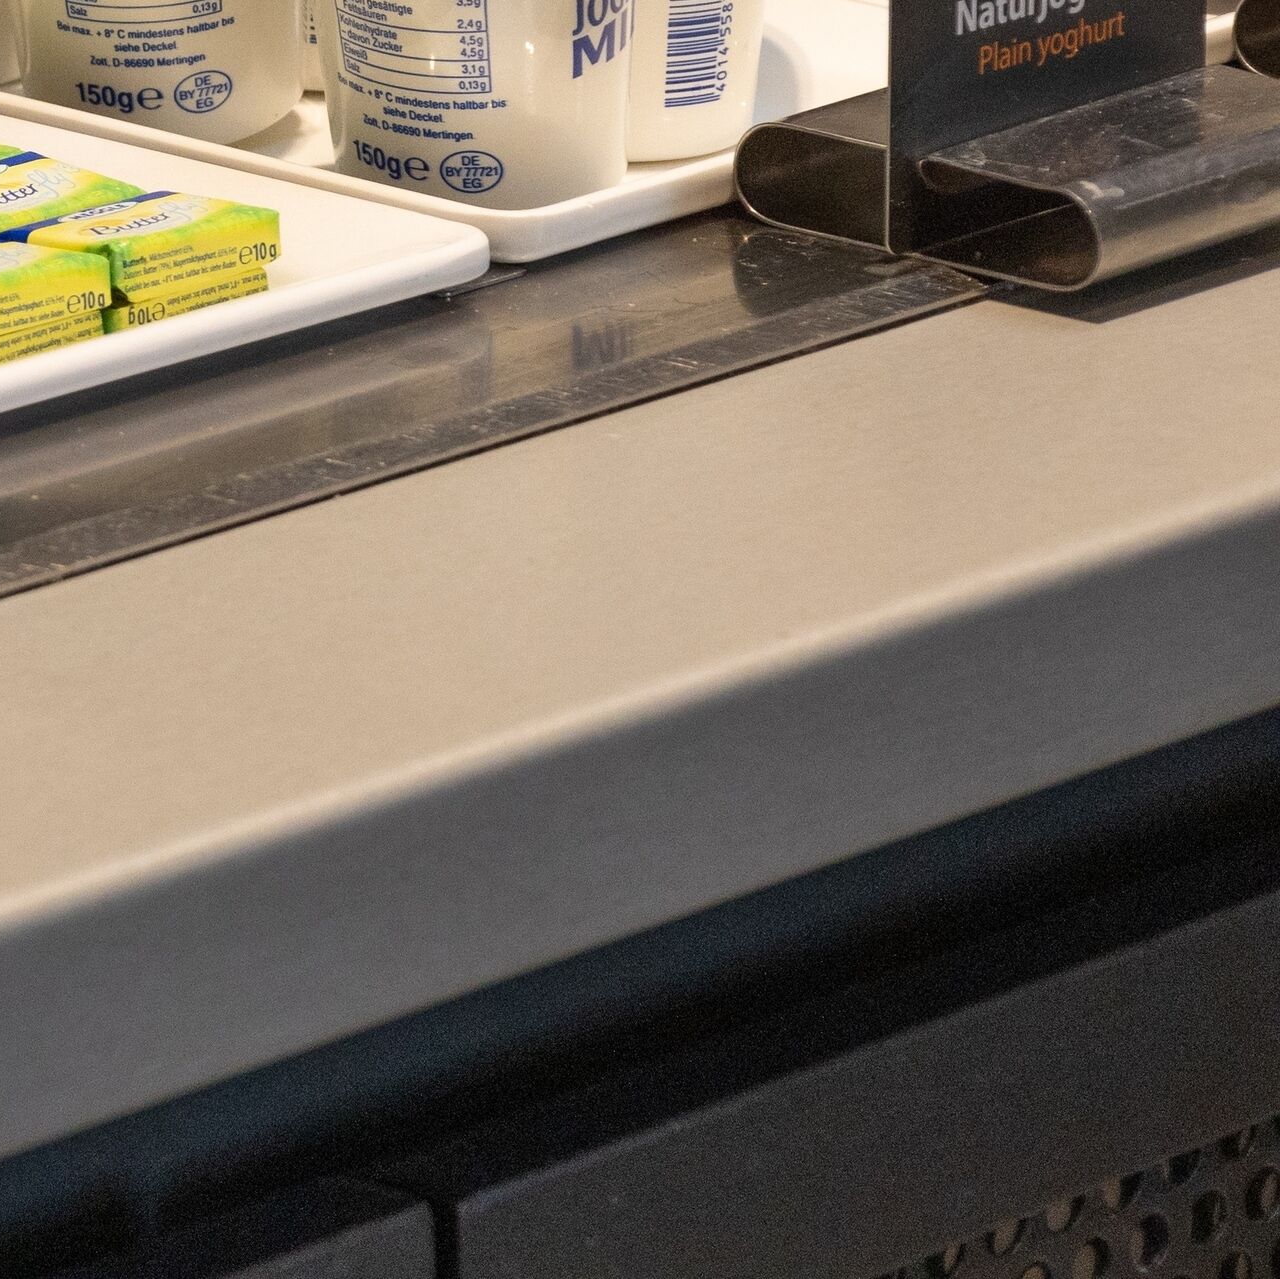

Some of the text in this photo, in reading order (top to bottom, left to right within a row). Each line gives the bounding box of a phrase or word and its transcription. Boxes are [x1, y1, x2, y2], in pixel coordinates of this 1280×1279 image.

[69, 6, 87, 17] Salz
[343, 0, 388, 22] Fettsäuren
[128, 27, 184, 39] mindestens
[186, 21, 219, 34] haltbar
[222, 15, 235, 26] bis
[339, 15, 398, 40] Kohlenhydrate
[114, 43, 140, 52] siehe
[372, 37, 403, 53] Zucker
[977, 10, 1126, 76] Plain yoghurt
[157, 53, 206, 67] Mertingen
[194, 76, 212, 87] DE
[179, 83, 229, 101] BY 77721
[195, 97, 214, 109] EG
[395, 95, 450, 110] mindestens
[453, 100, 488, 110] haltbar
[491, 100, 506, 108] bis
[383, 105, 407, 119] siehe
[461, 156, 480, 166] DE
[445, 167, 499, 177] BY 77721
[463, 178, 482, 189] EG
